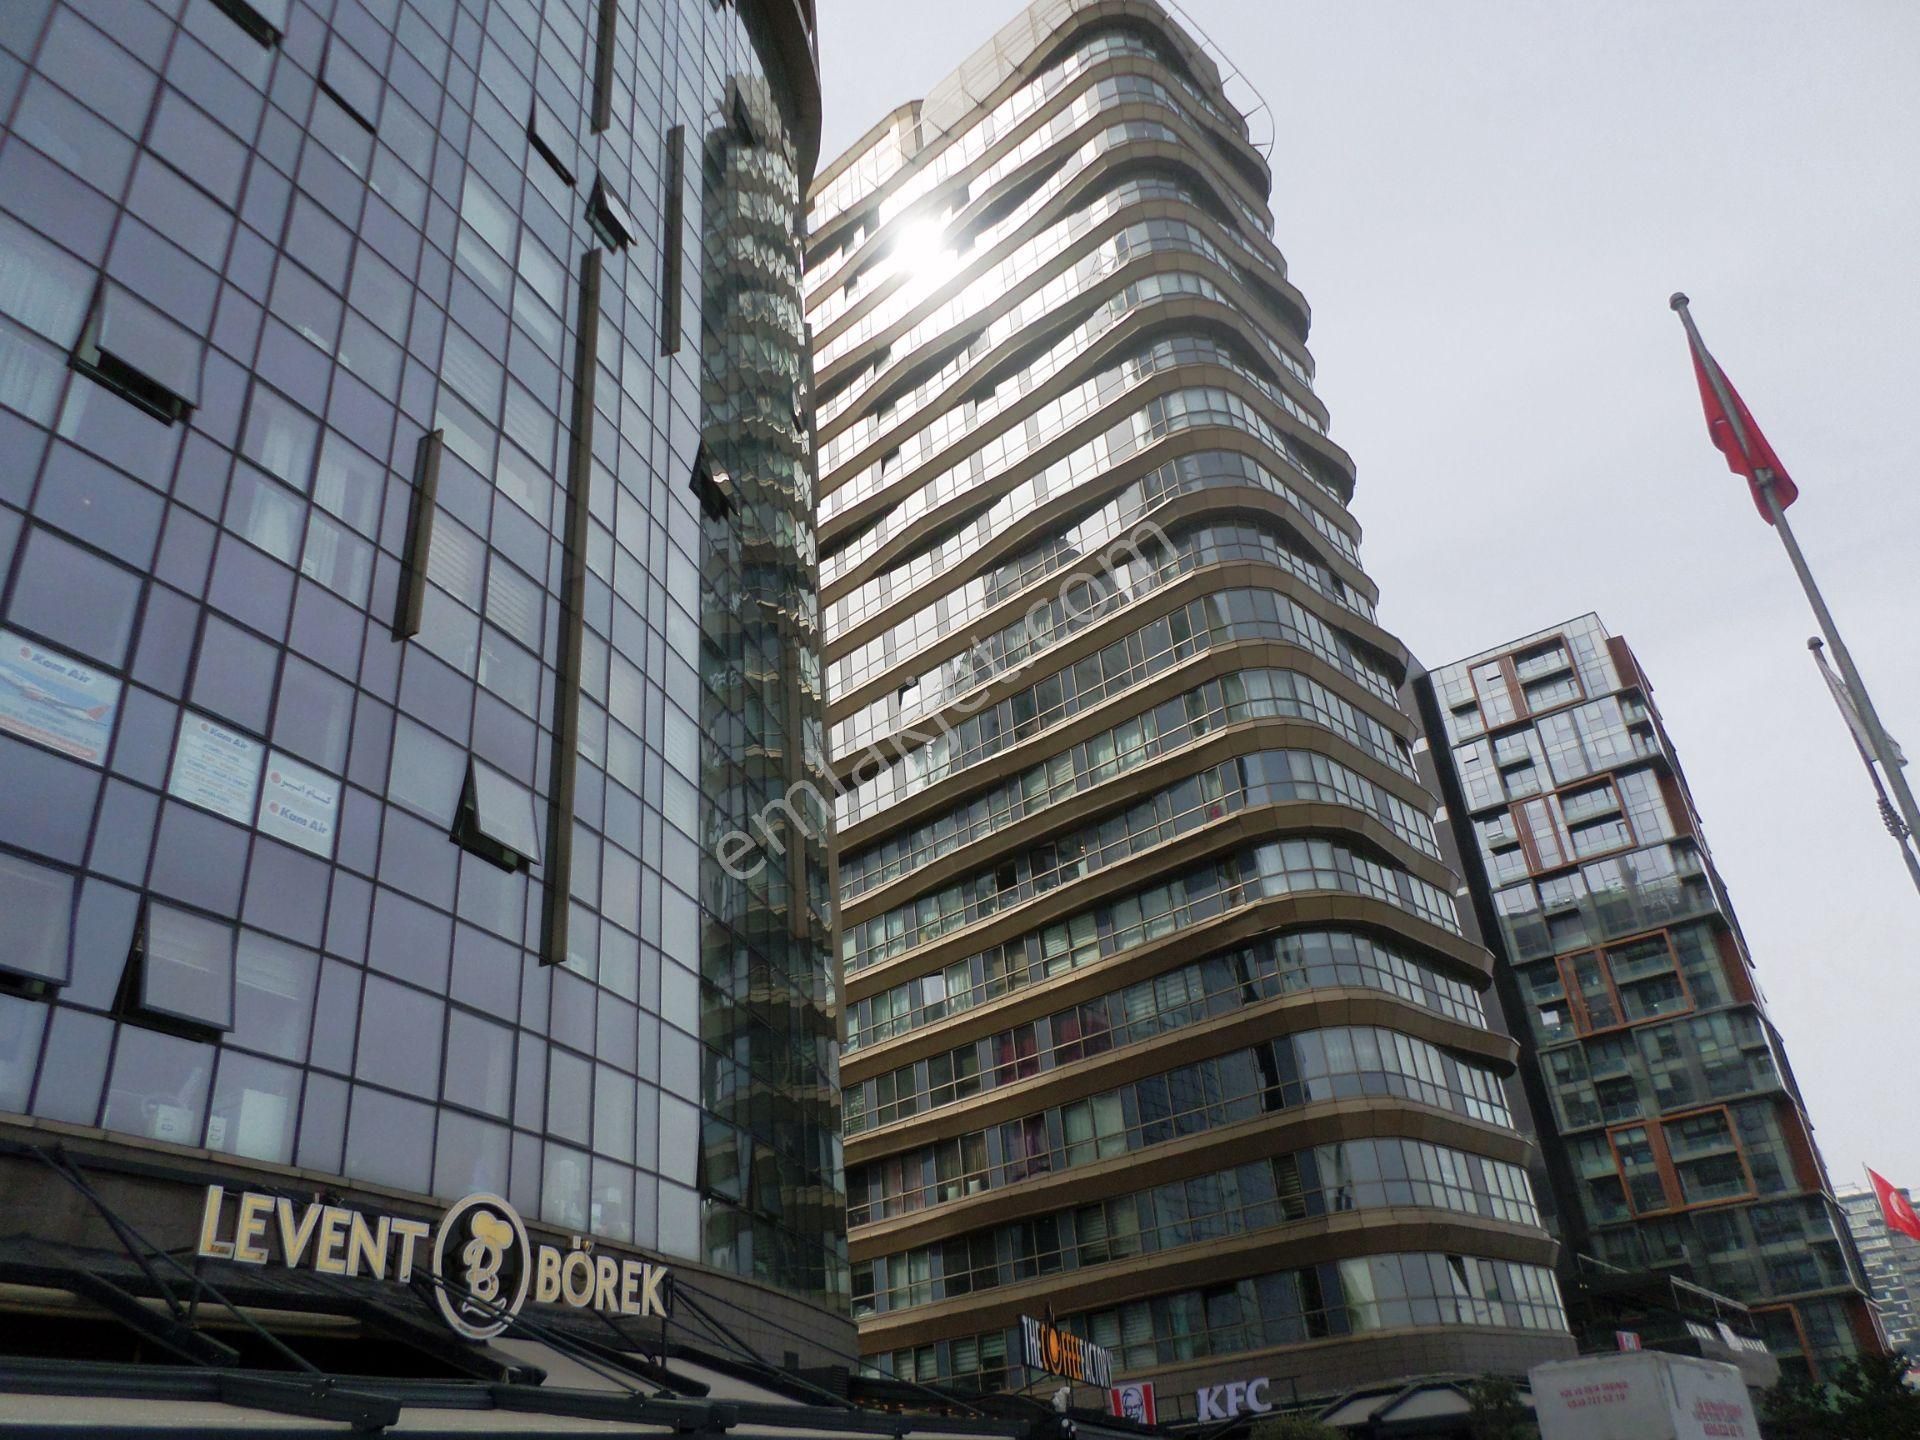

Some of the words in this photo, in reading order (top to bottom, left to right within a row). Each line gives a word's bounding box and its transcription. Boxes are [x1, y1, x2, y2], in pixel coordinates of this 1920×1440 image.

[67, 668, 91, 683] Air
[280, 807, 308, 826] Kam
[309, 818, 328, 834] Air
[198, 1184, 430, 1284] LEVENT
[536, 1235, 668, 1318] BÖREK
[1021, 1314, 1043, 1370] THE
[1040, 1322, 1084, 1382] COFFEE
[1079, 1338, 1113, 1389] FACTORY
[1196, 1377, 1272, 1422] KFC
